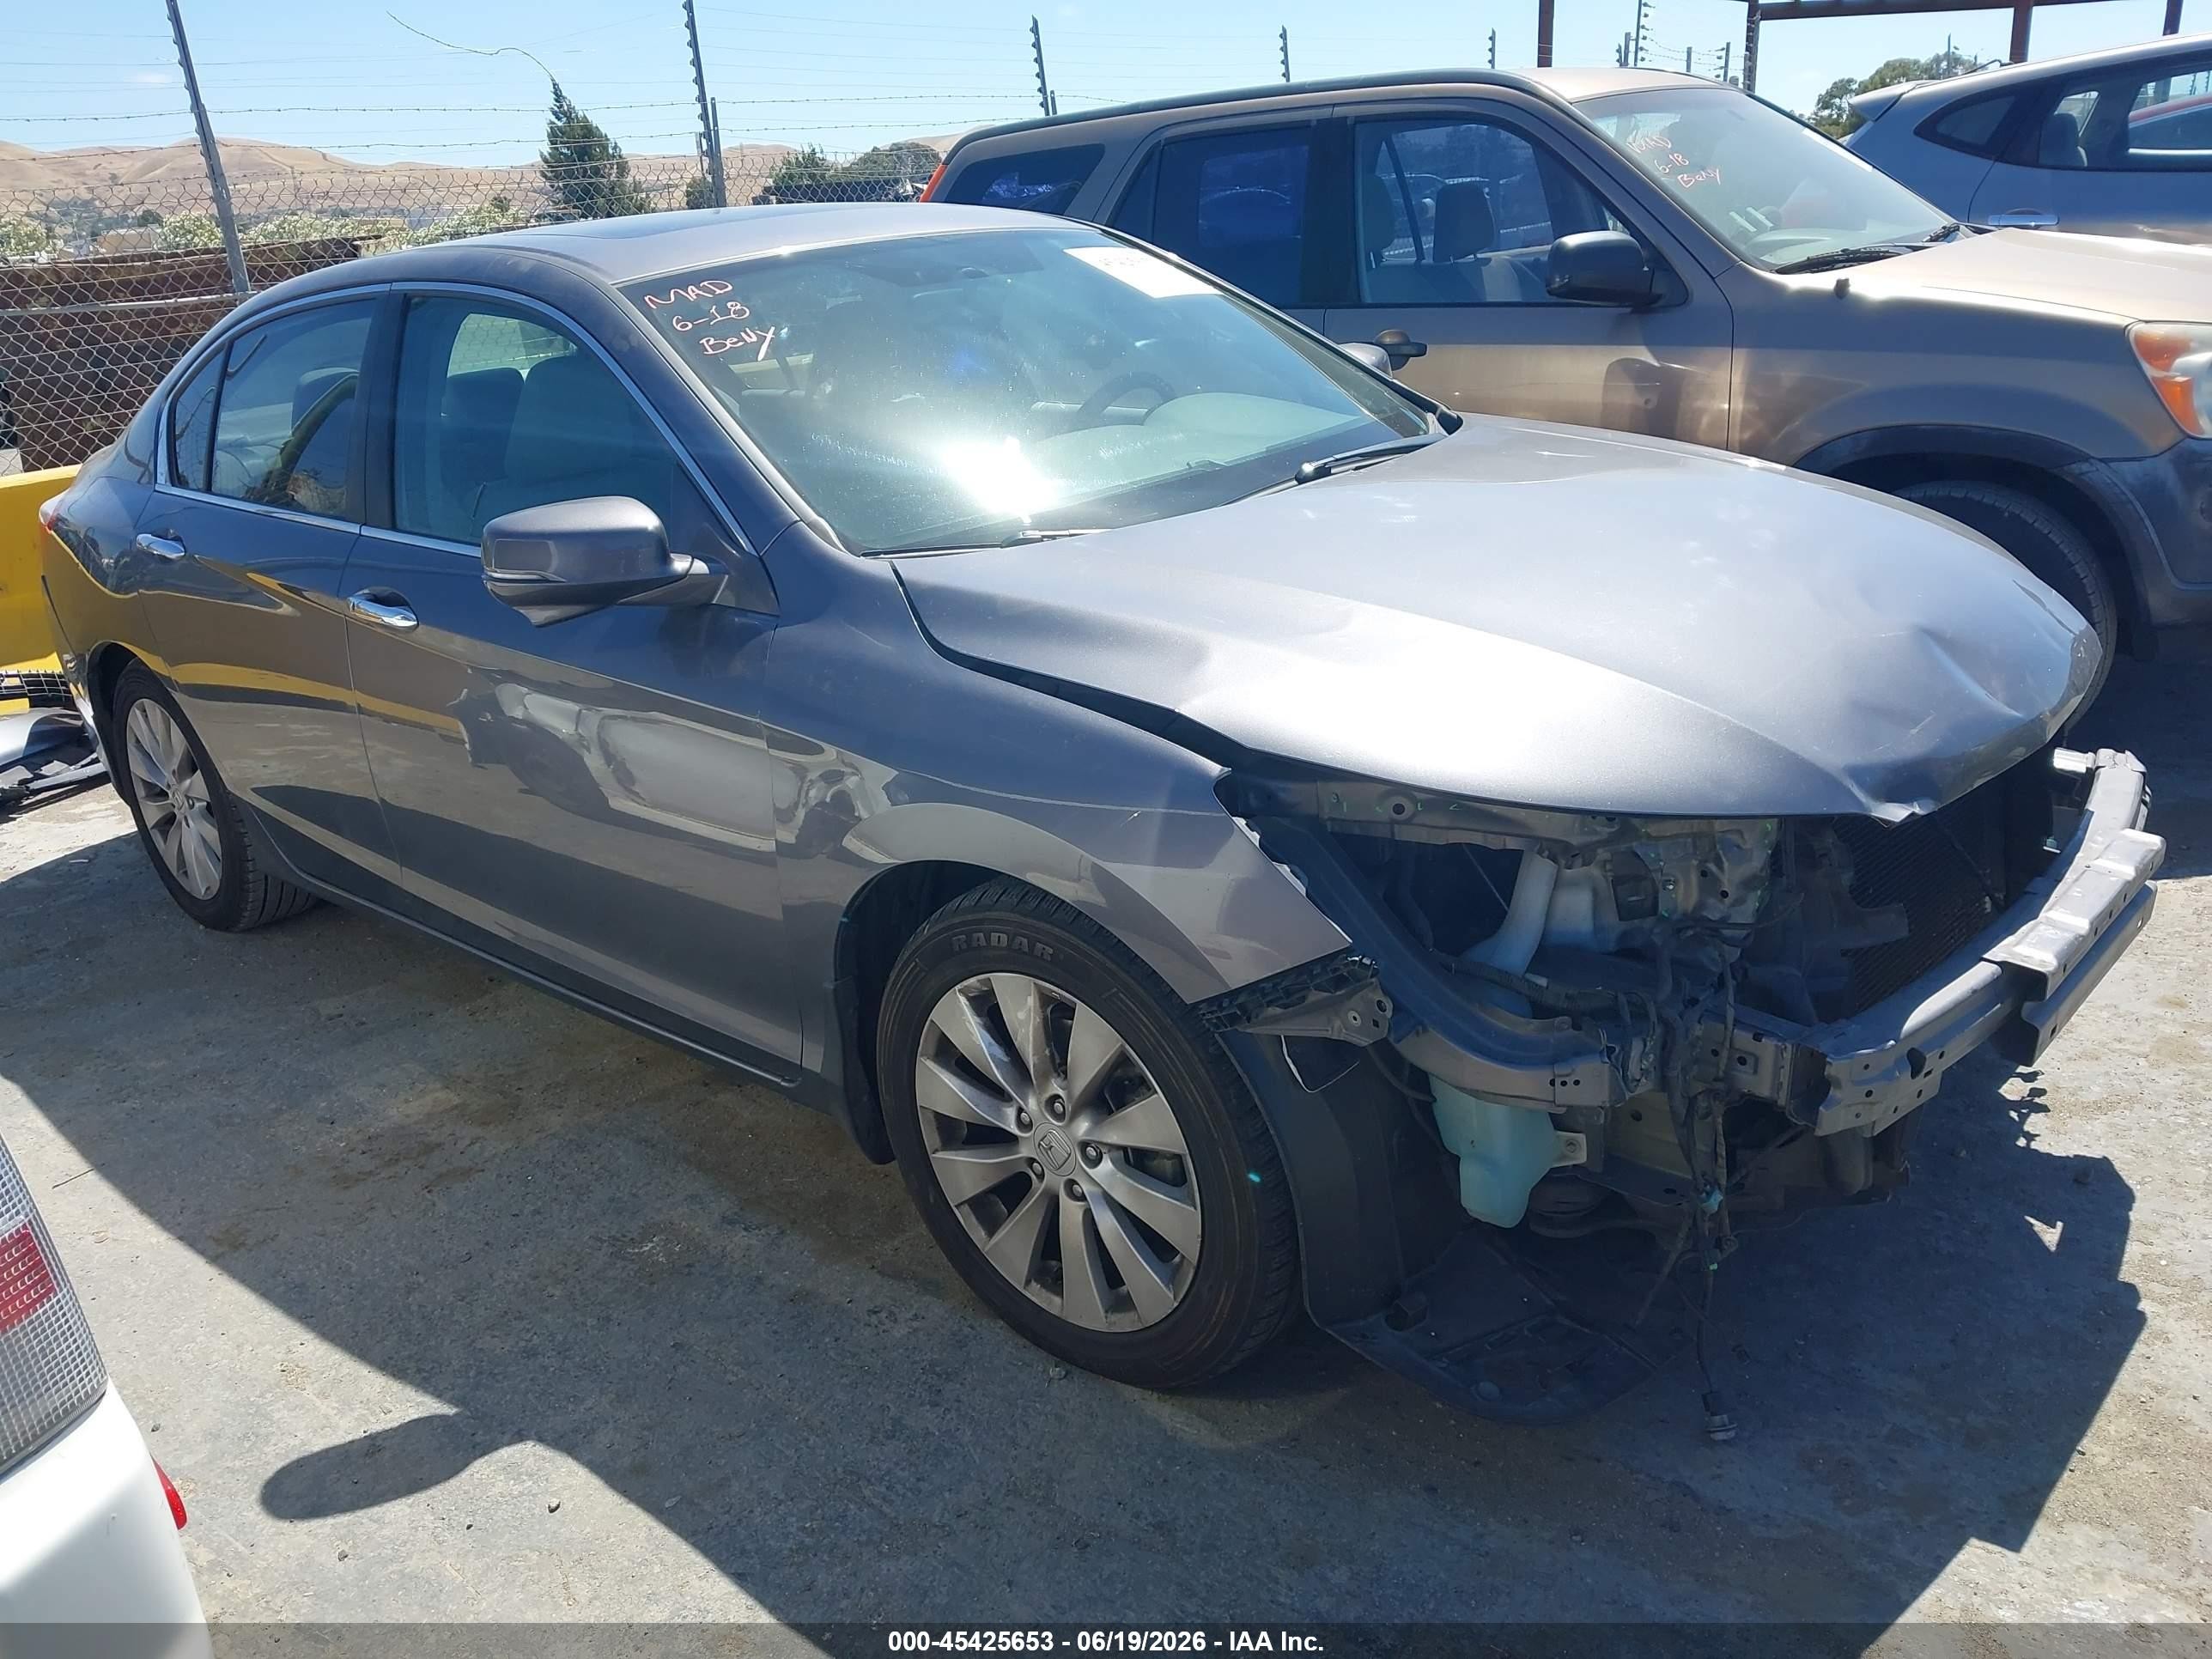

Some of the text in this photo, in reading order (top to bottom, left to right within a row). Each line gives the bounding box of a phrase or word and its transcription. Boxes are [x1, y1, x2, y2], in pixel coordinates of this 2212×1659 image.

[1654, 152, 1690, 173] 6-18
[644, 279, 733, 309] MAD
[672, 301, 750, 331] 6-18
[951, 932, 1054, 962] RADAR
